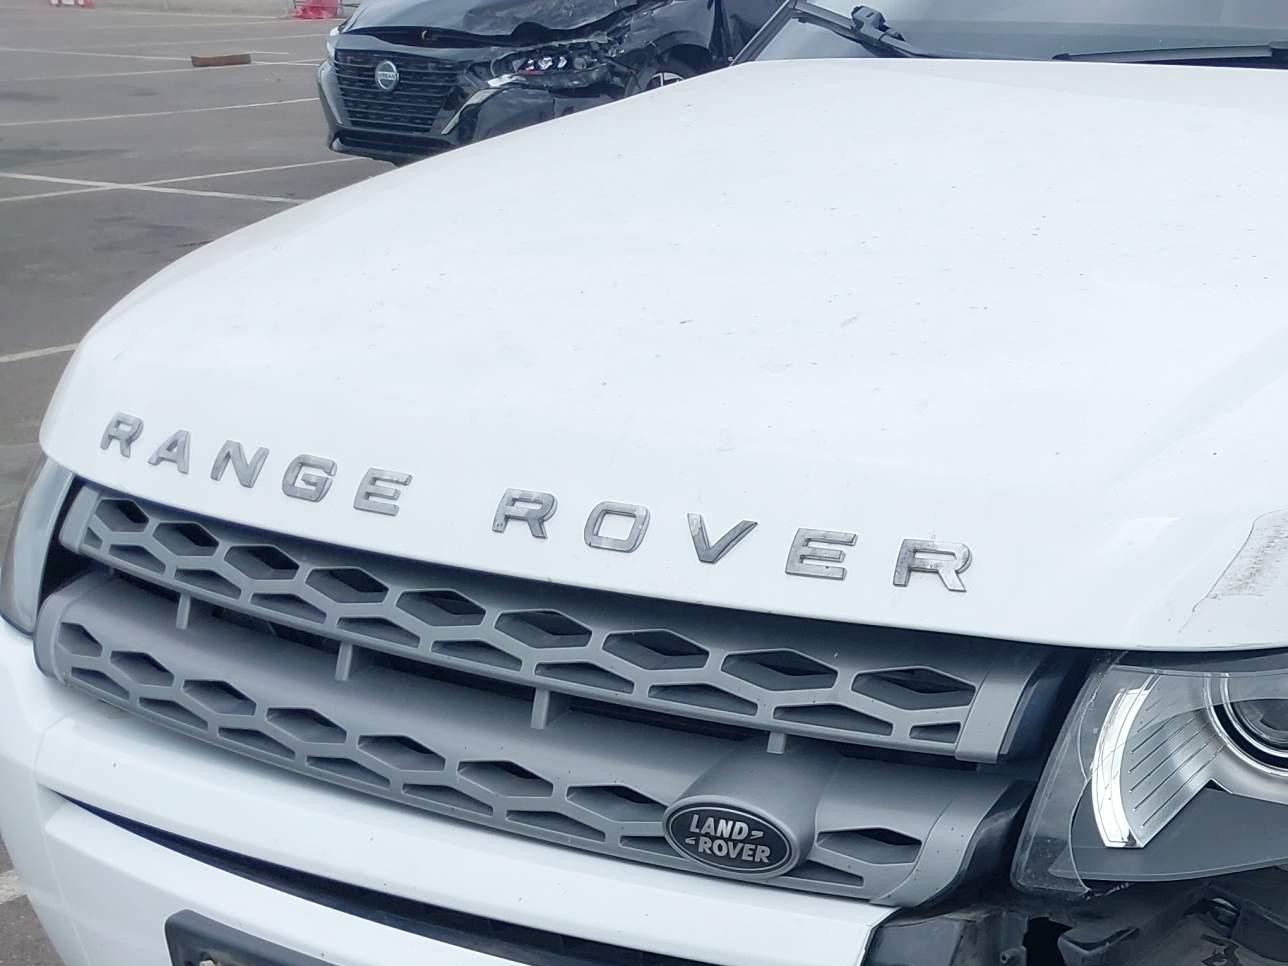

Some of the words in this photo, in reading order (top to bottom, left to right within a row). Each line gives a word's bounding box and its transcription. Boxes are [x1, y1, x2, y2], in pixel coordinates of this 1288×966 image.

[99, 411, 413, 516] RANGE
[491, 487, 973, 593] ROVER
[698, 836, 771, 863] ROVER
